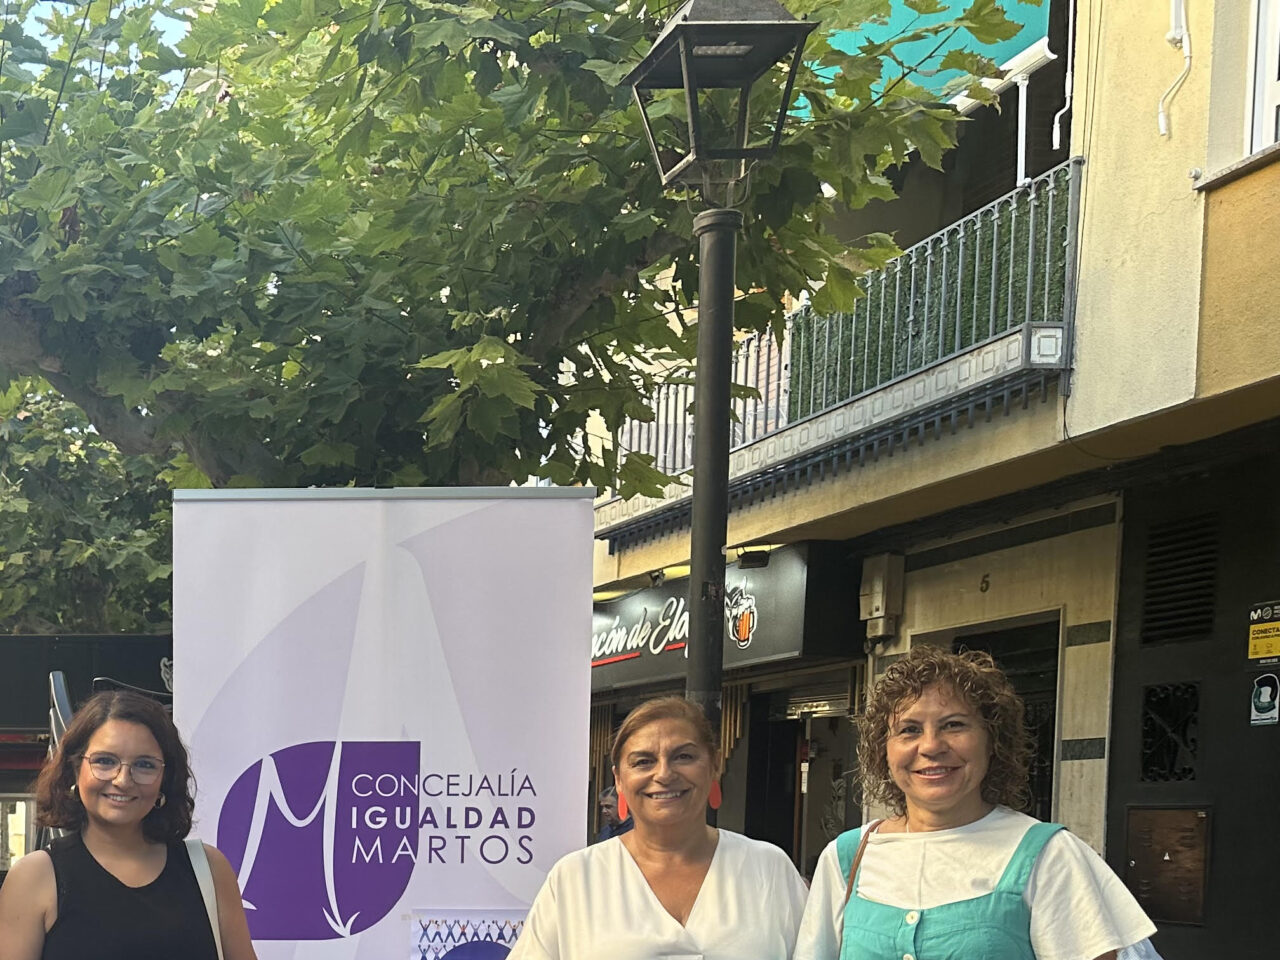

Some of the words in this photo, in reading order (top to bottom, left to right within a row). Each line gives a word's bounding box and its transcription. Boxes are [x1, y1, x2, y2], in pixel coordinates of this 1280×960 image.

[980, 572, 990, 592] 5
[351, 768, 538, 798] CONCEJALÍA
[351, 806, 536, 830] IGUALDAD
[351, 834, 534, 864] MARTOS
